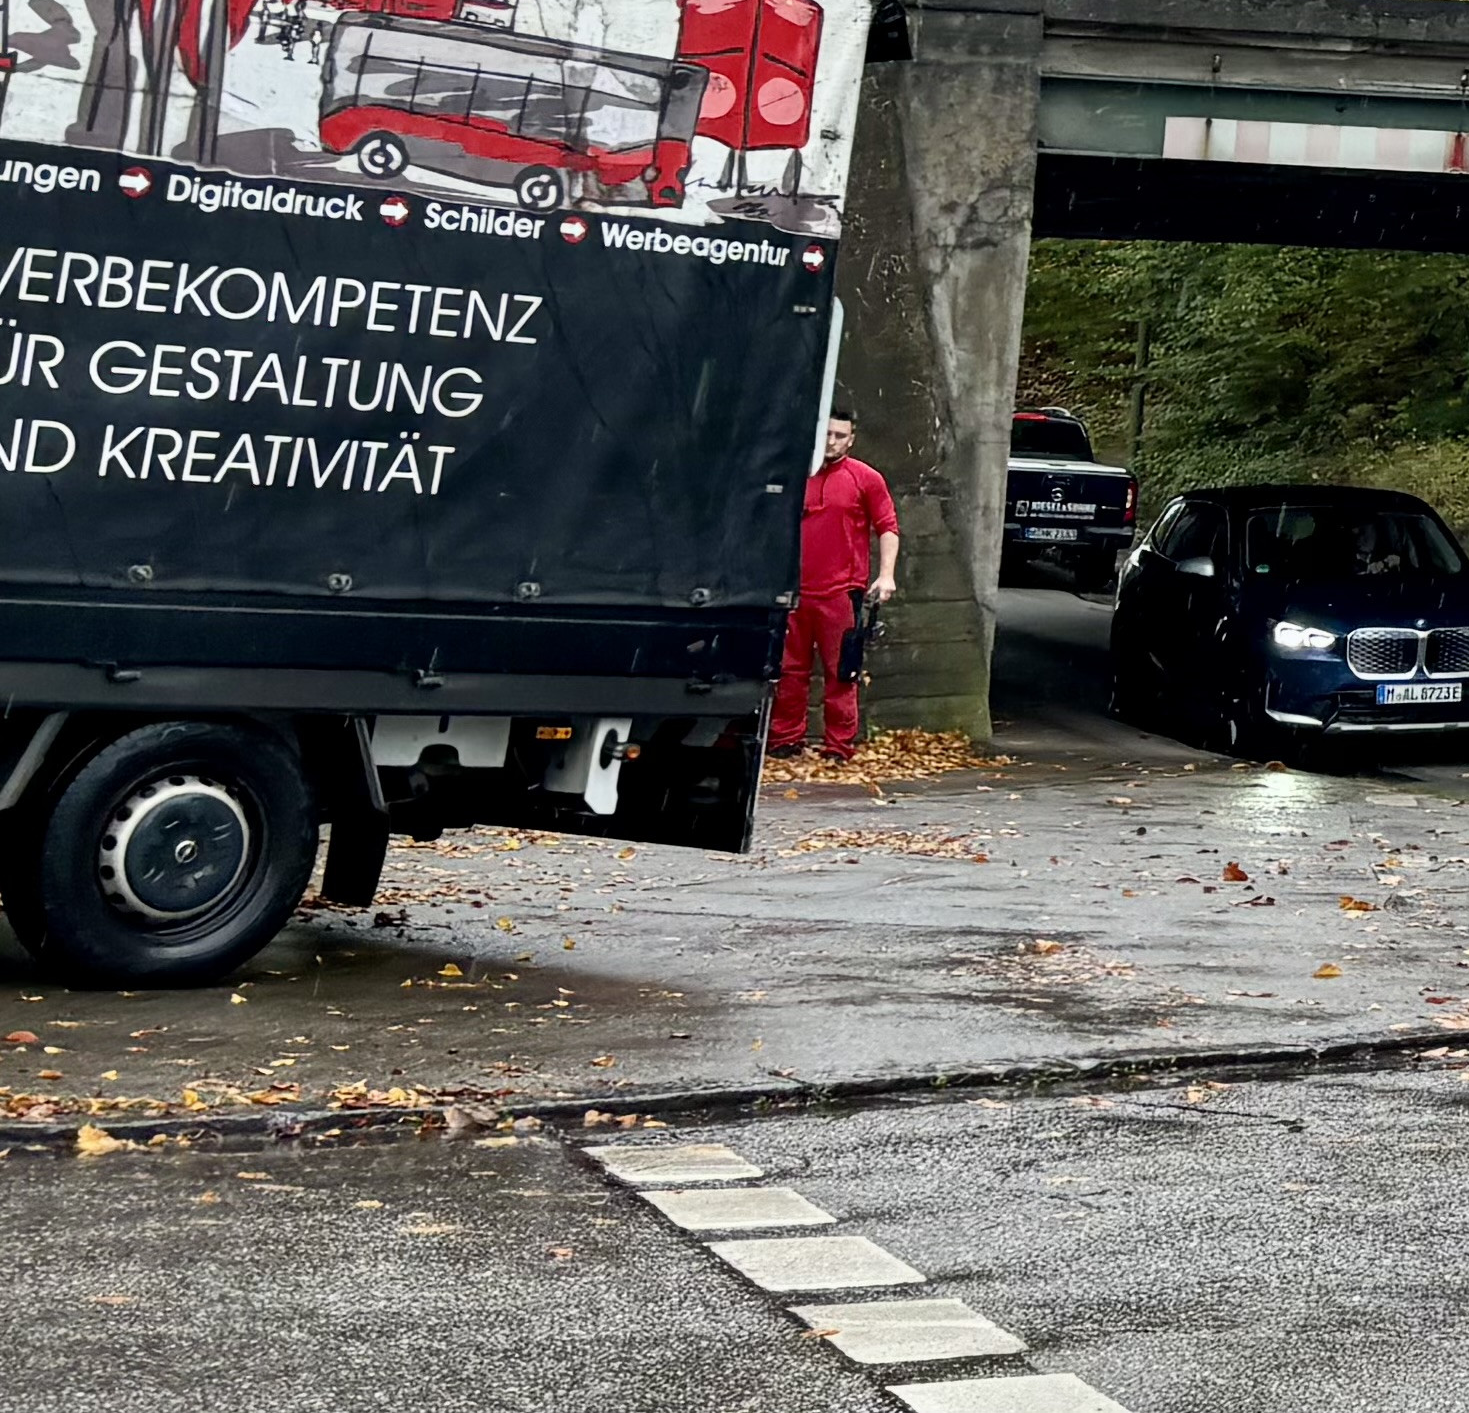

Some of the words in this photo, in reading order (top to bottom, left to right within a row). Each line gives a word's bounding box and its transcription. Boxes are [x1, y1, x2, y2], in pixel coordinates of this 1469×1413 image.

[166, 174, 364, 221] Digitaldruck
[423, 202, 545, 239] Schilder
[601, 221, 790, 266] Werbeagentur
[0, 247, 543, 344] ERBEKOMPETENZ
[89, 340, 484, 418] GESTALTUNG
[98, 424, 456, 495] KREATIVITÄT
[1387, 688, 1395, 702] M
